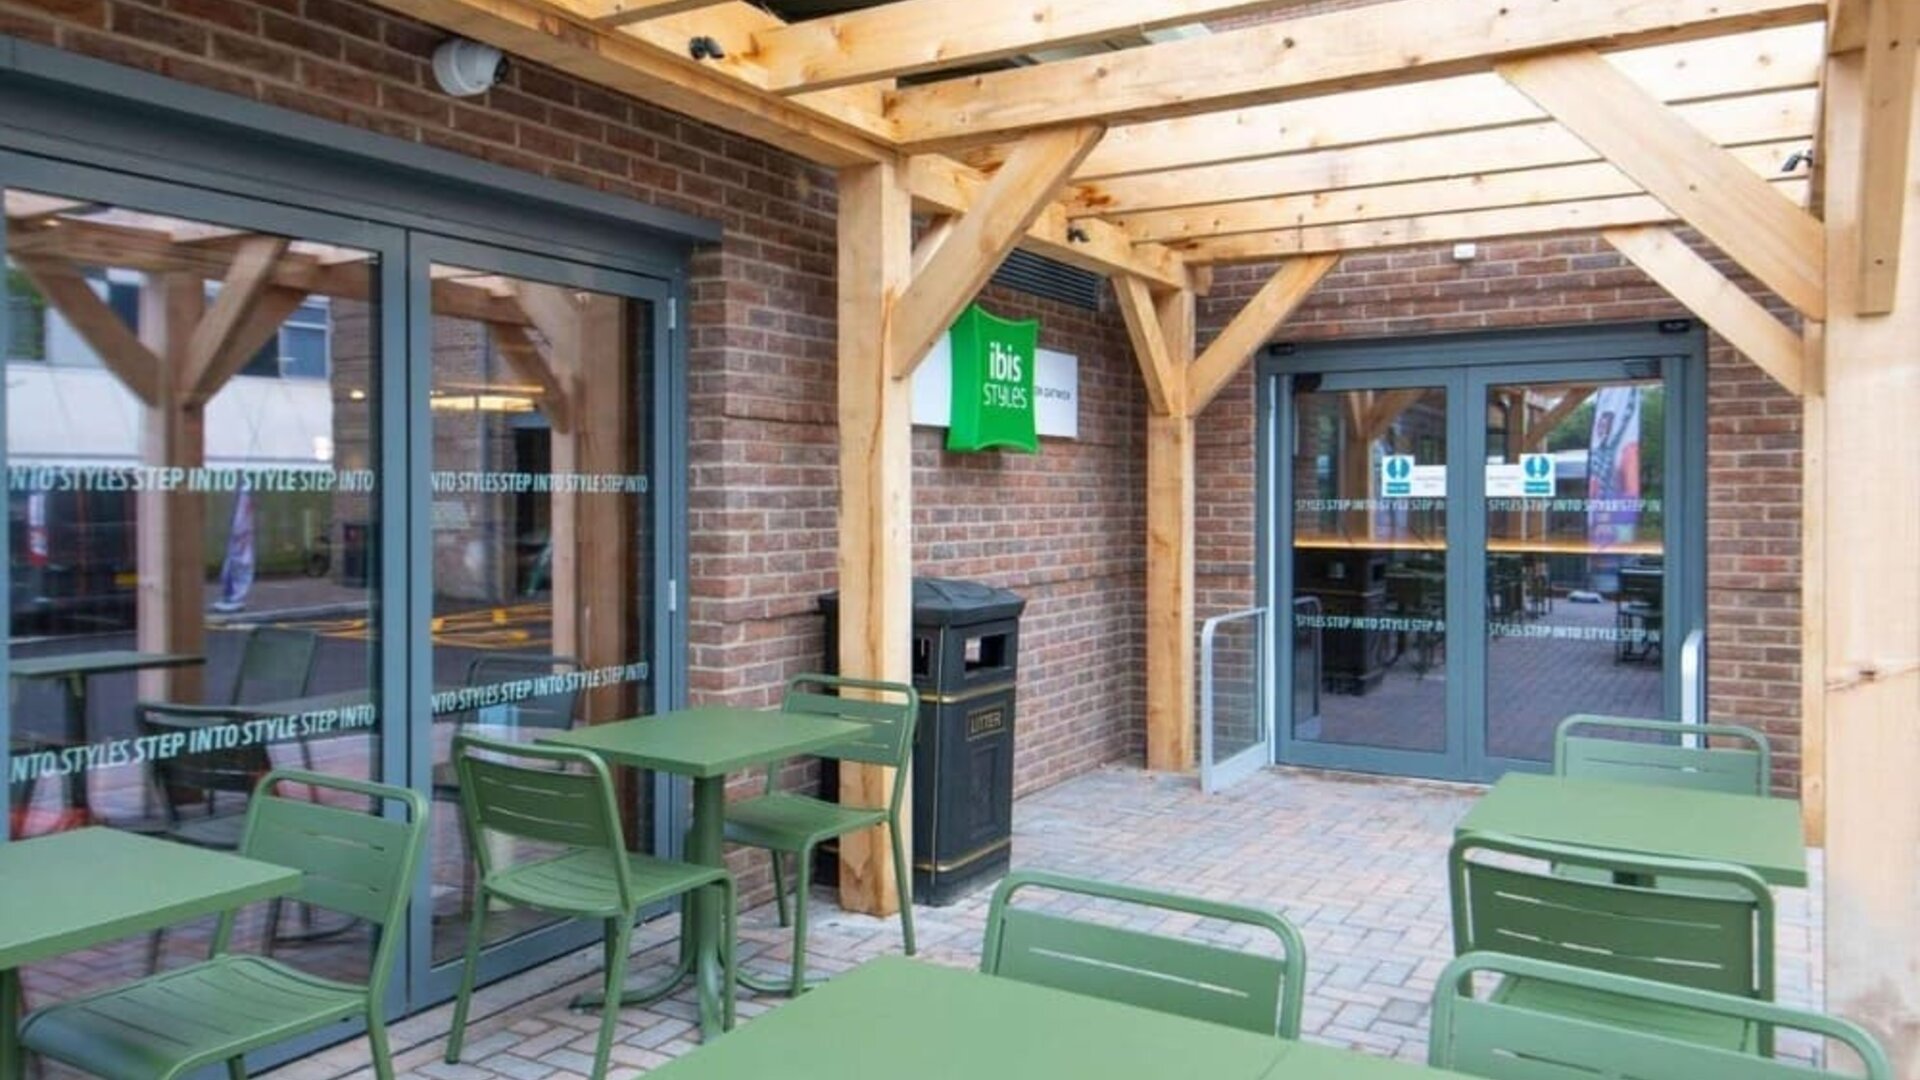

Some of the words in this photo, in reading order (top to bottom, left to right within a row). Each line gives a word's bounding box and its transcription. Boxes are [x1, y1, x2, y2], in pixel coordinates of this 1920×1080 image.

[989, 342, 1022, 382] ibis
[58, 466, 129, 491] STYLES
[131, 467, 184, 491] STEP
[187, 467, 236, 491] INTO
[240, 467, 297, 491] STYLE
[299, 469, 336, 492] STEP
[338, 469, 374, 492] INTO
[457, 471, 500, 493] STYLES
[500, 472, 532, 493] STEP
[533, 473, 563, 493] INTO
[565, 474, 599, 493] STYLE
[601, 475, 624, 493] STEP
[458, 682, 500, 710] STYLES
[500, 679, 532, 702] STEP
[533, 674, 563, 697] INTO
[565, 670, 599, 693] STYLE
[601, 665, 625, 687] STEP
[625, 662, 648, 681] INTO
[970, 711, 1001, 734] LITTER
[59, 738, 130, 776] STYLES
[133, 731, 185, 765] STEP
[188, 724, 239, 754] INTO
[241, 714, 298, 745] STYLE
[300, 708, 337, 736] STEP
[338, 703, 375, 728] INTO
